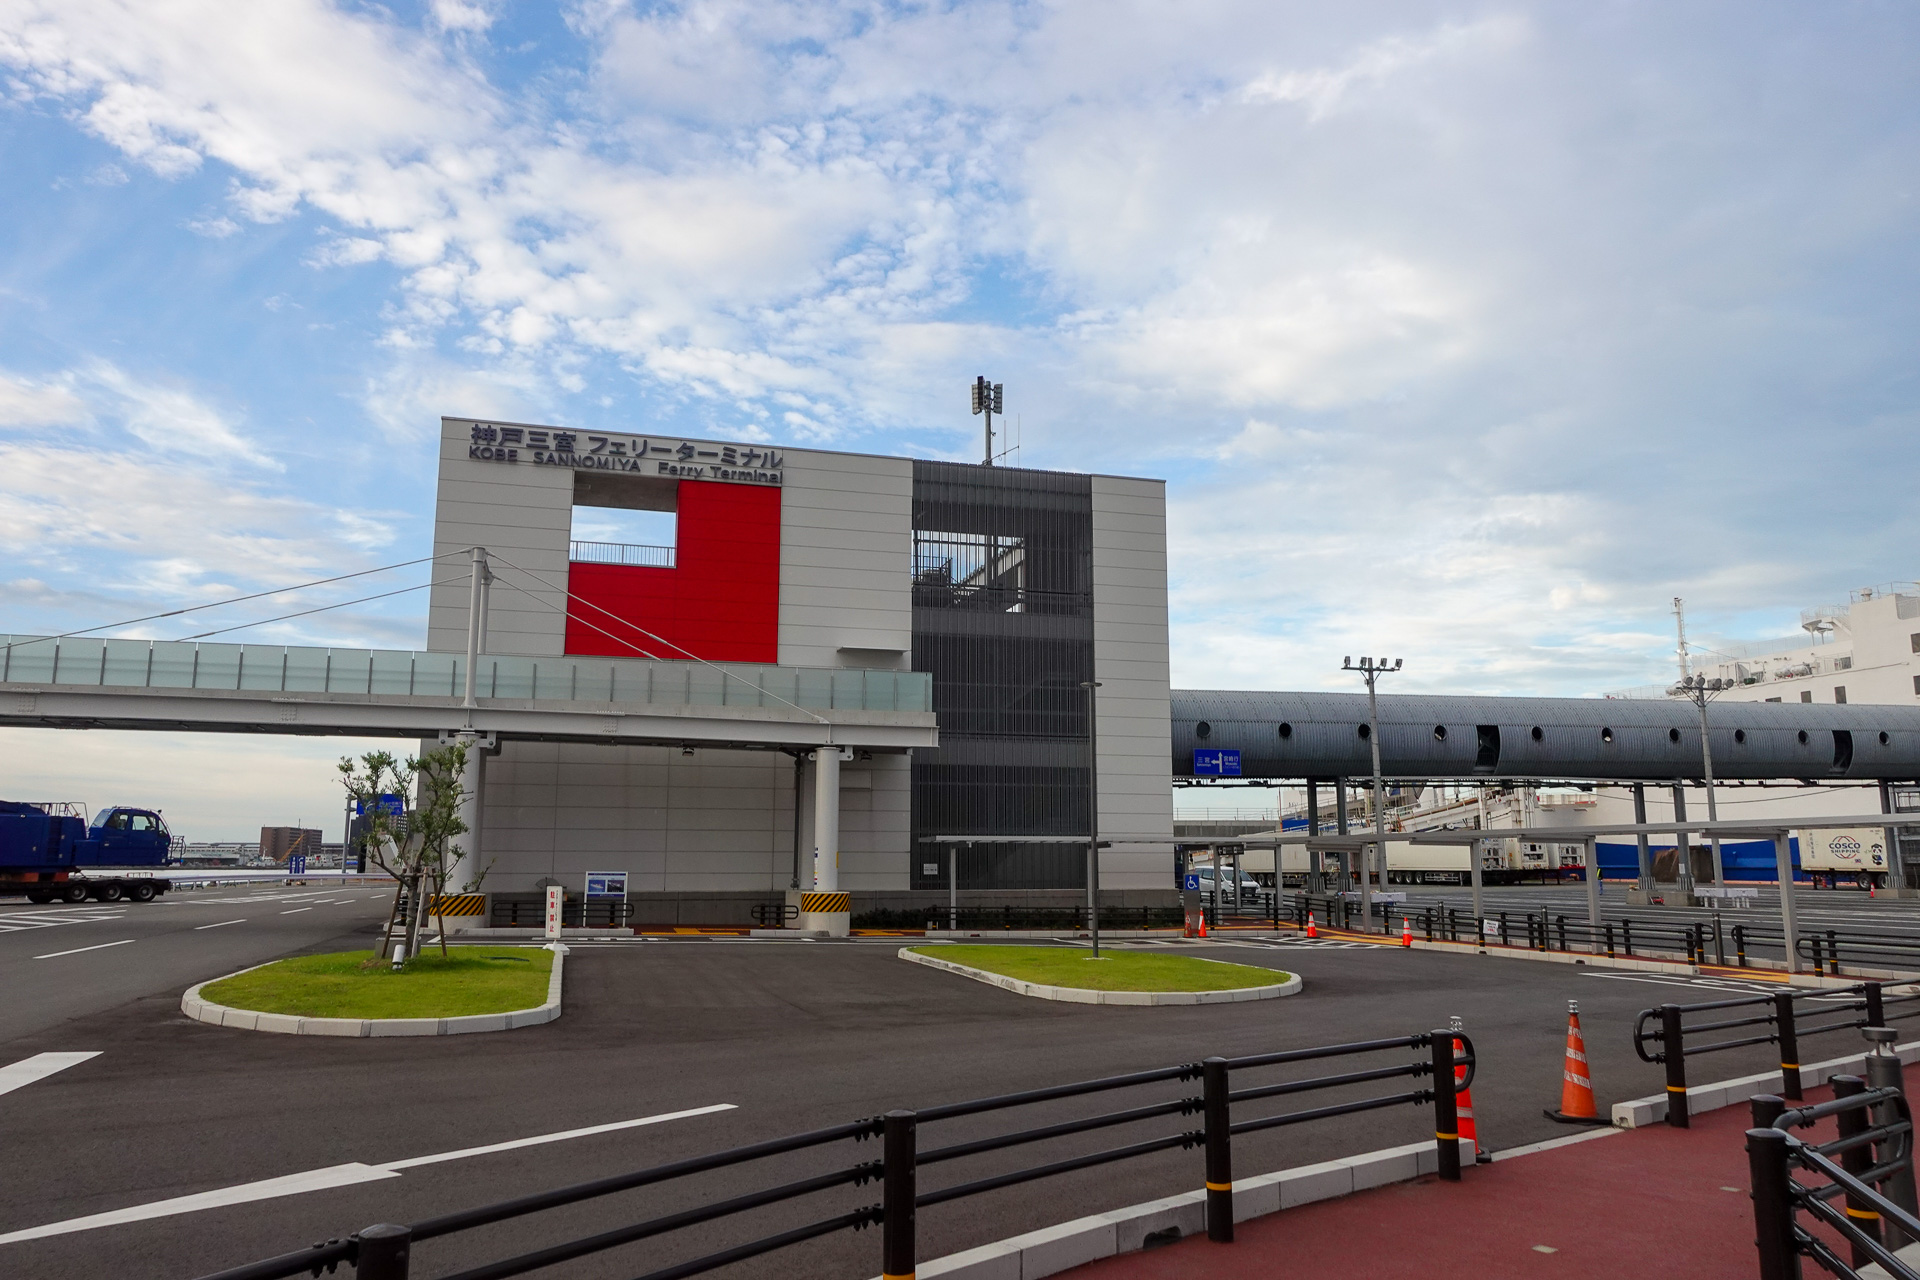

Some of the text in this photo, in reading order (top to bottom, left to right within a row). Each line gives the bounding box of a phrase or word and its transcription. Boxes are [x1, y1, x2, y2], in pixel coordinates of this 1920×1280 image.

[469, 445, 783, 484] KOBE SANNOMIYA Ferry Terminal
[471, 423, 783, 469] 神戸三宮 フェリーターミナル
